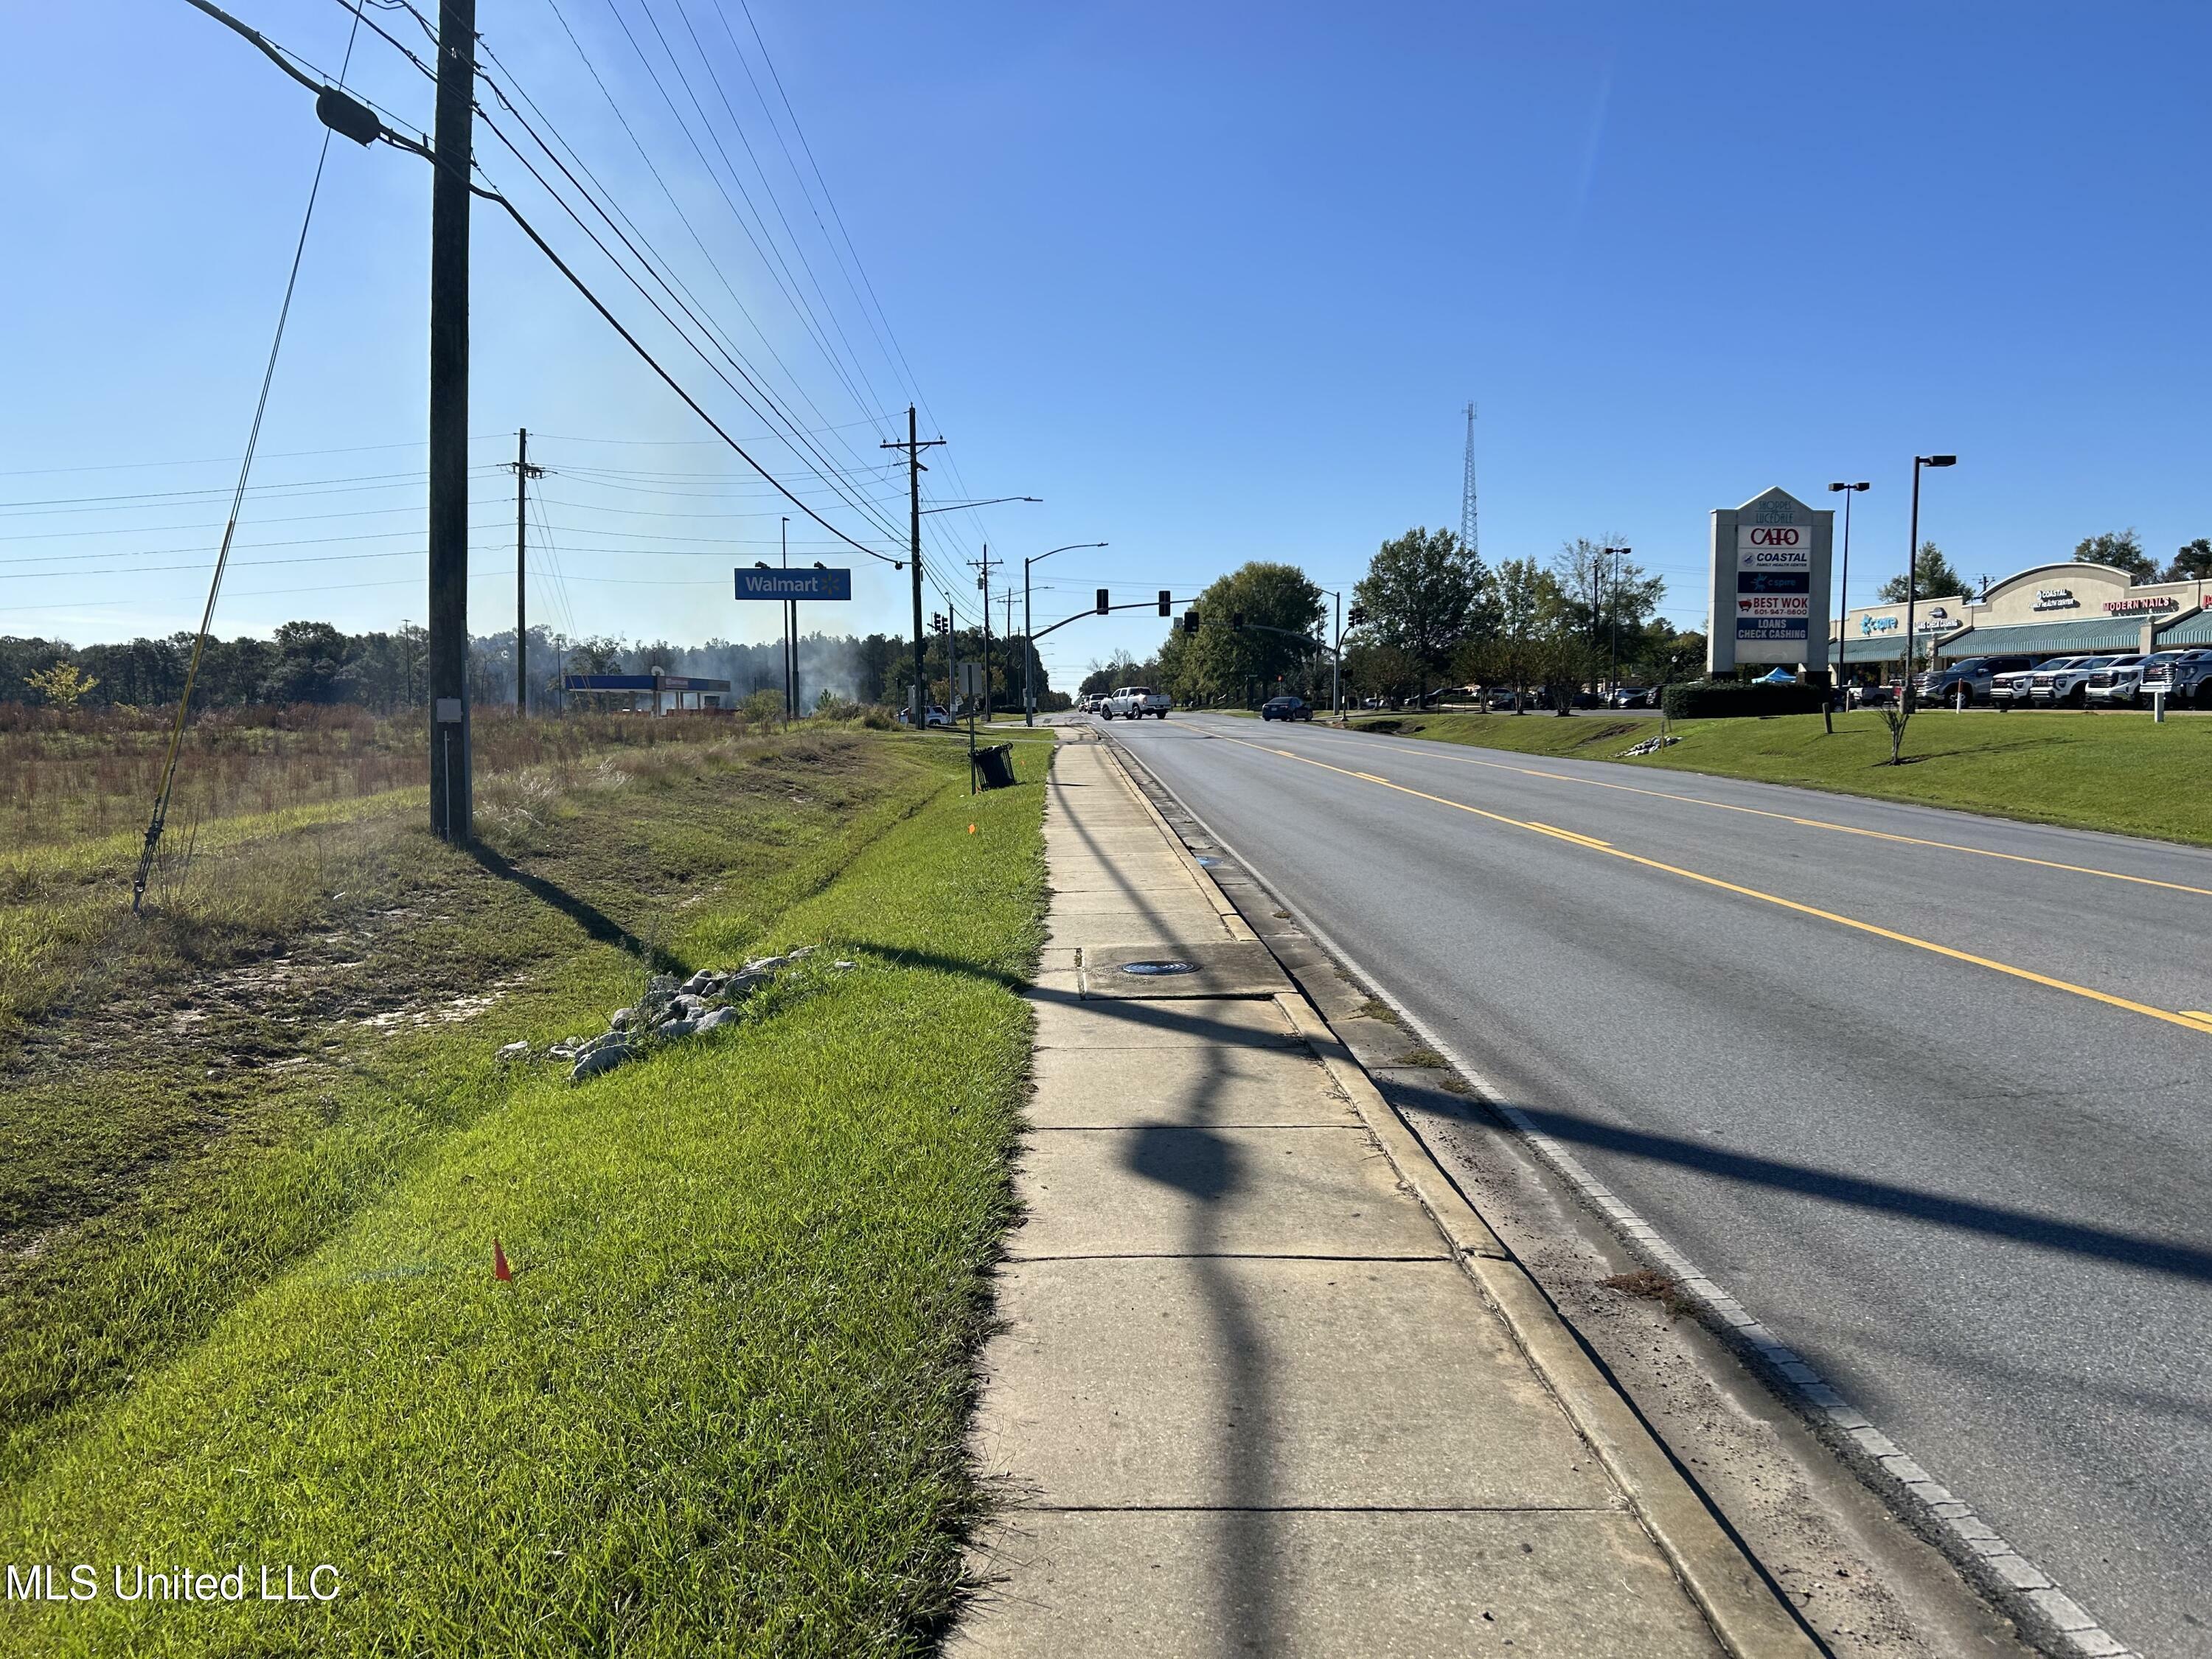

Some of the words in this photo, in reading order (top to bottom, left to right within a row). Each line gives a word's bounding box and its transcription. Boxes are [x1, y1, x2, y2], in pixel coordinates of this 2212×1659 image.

[1759, 500, 1792, 510] SHOPPES
[1756, 512, 1794, 524] LUCEDALE
[1750, 527, 1799, 546] CATO
[1756, 552, 1807, 562] COASTAL
[745, 576, 818, 592] Walmart
[1774, 578, 1796, 588] spire
[2042, 588, 2067, 599] COASTAL
[1753, 597, 1779, 608] BEST
[1781, 597, 1808, 608] WOK
[2103, 599, 2140, 611] MODERN
[2141, 597, 2171, 608] NAILS
[1758, 619, 1787, 628] LOANS
[1738, 630, 1767, 639] CHECK
[1768, 630, 1806, 639] CASHING
